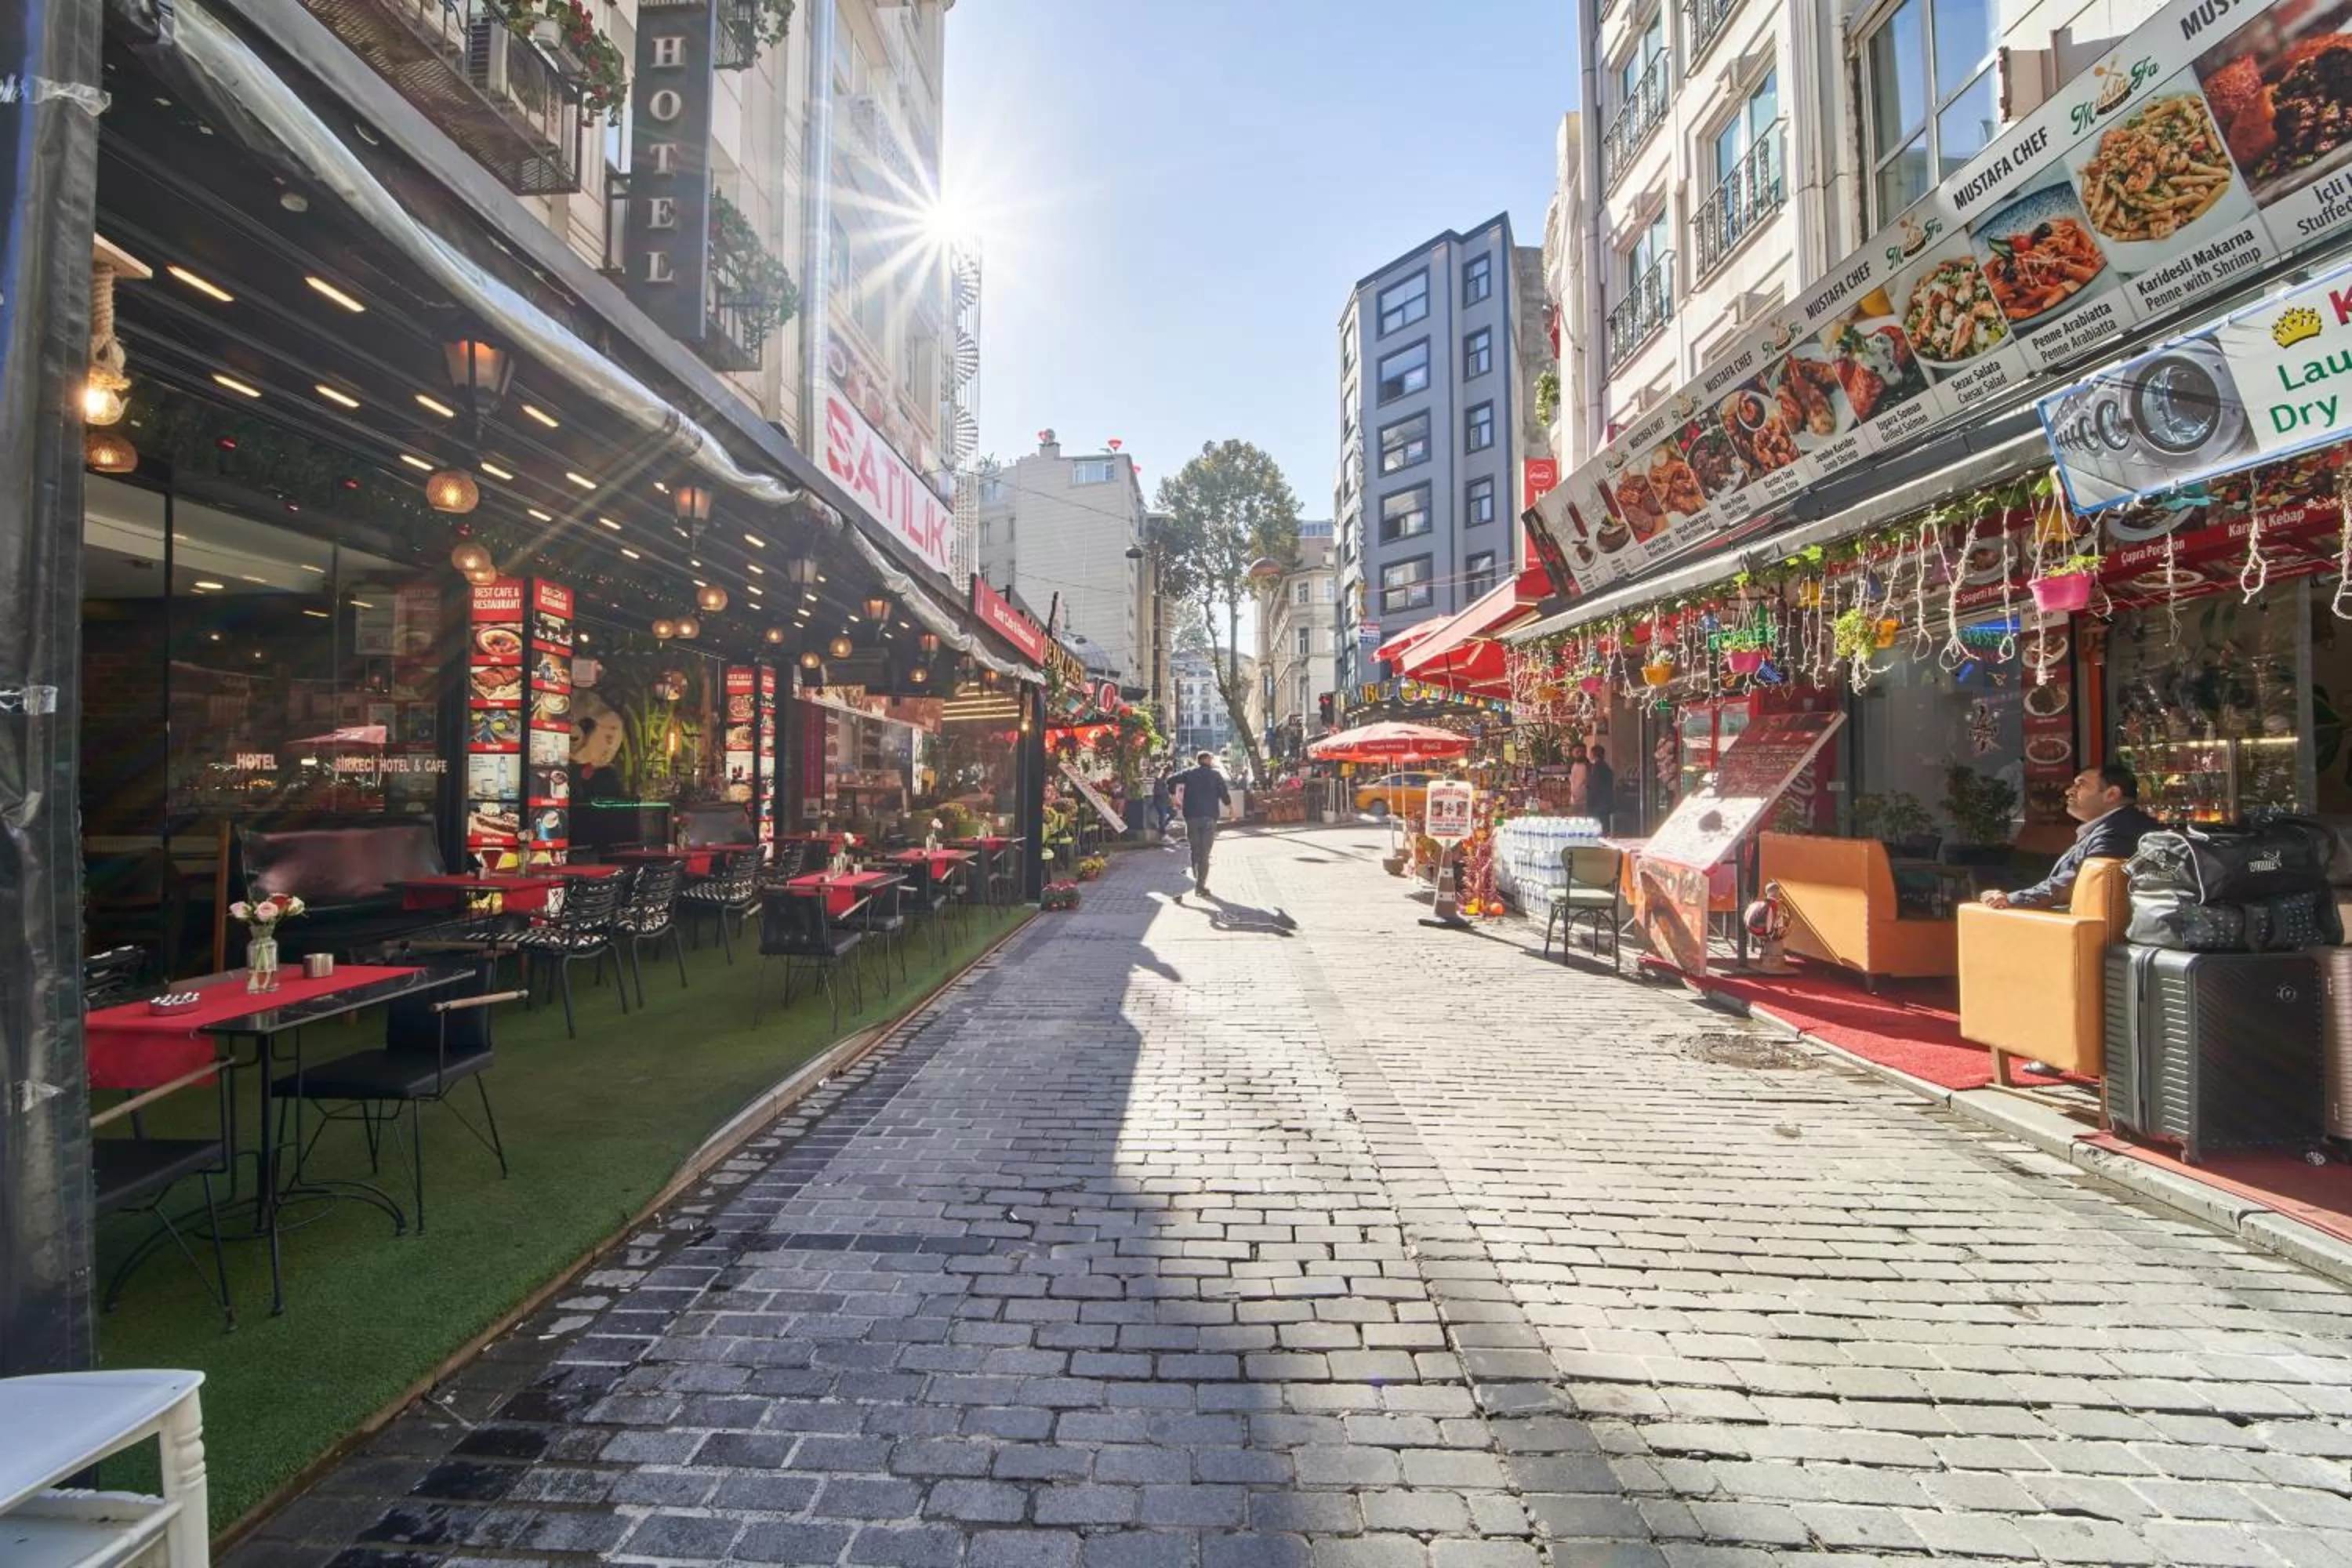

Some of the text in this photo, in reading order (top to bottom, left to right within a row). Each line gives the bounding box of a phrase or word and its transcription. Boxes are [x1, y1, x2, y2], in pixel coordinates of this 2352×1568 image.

[644, 36, 688, 284] HOTEL
[1953, 126, 2050, 210] MUSTAFA CHEF
[2136, 227, 2255, 296] Karidesli Makarna
[2145, 246, 2263, 312] Penne with Shrimp
[1806, 261, 1871, 320] MUSTAFA CHEF
[2031, 302, 2113, 350] Penne Arabiatta
[2041, 319, 2118, 364] Penne Arabiatta
[2269, 394, 2337, 434] Dry
[826, 396, 951, 572] SATILIK
[2268, 509, 2306, 528] Kebap
[473, 598, 521, 609] RESTAURANT
[474, 587, 493, 597] BEST
[493, 587, 514, 597] CAFE
[236, 753, 278, 770] HOTEL
[379, 757, 410, 772] HOTEL
[413, 758, 421, 772] &
[424, 759, 448, 774] CAFE
